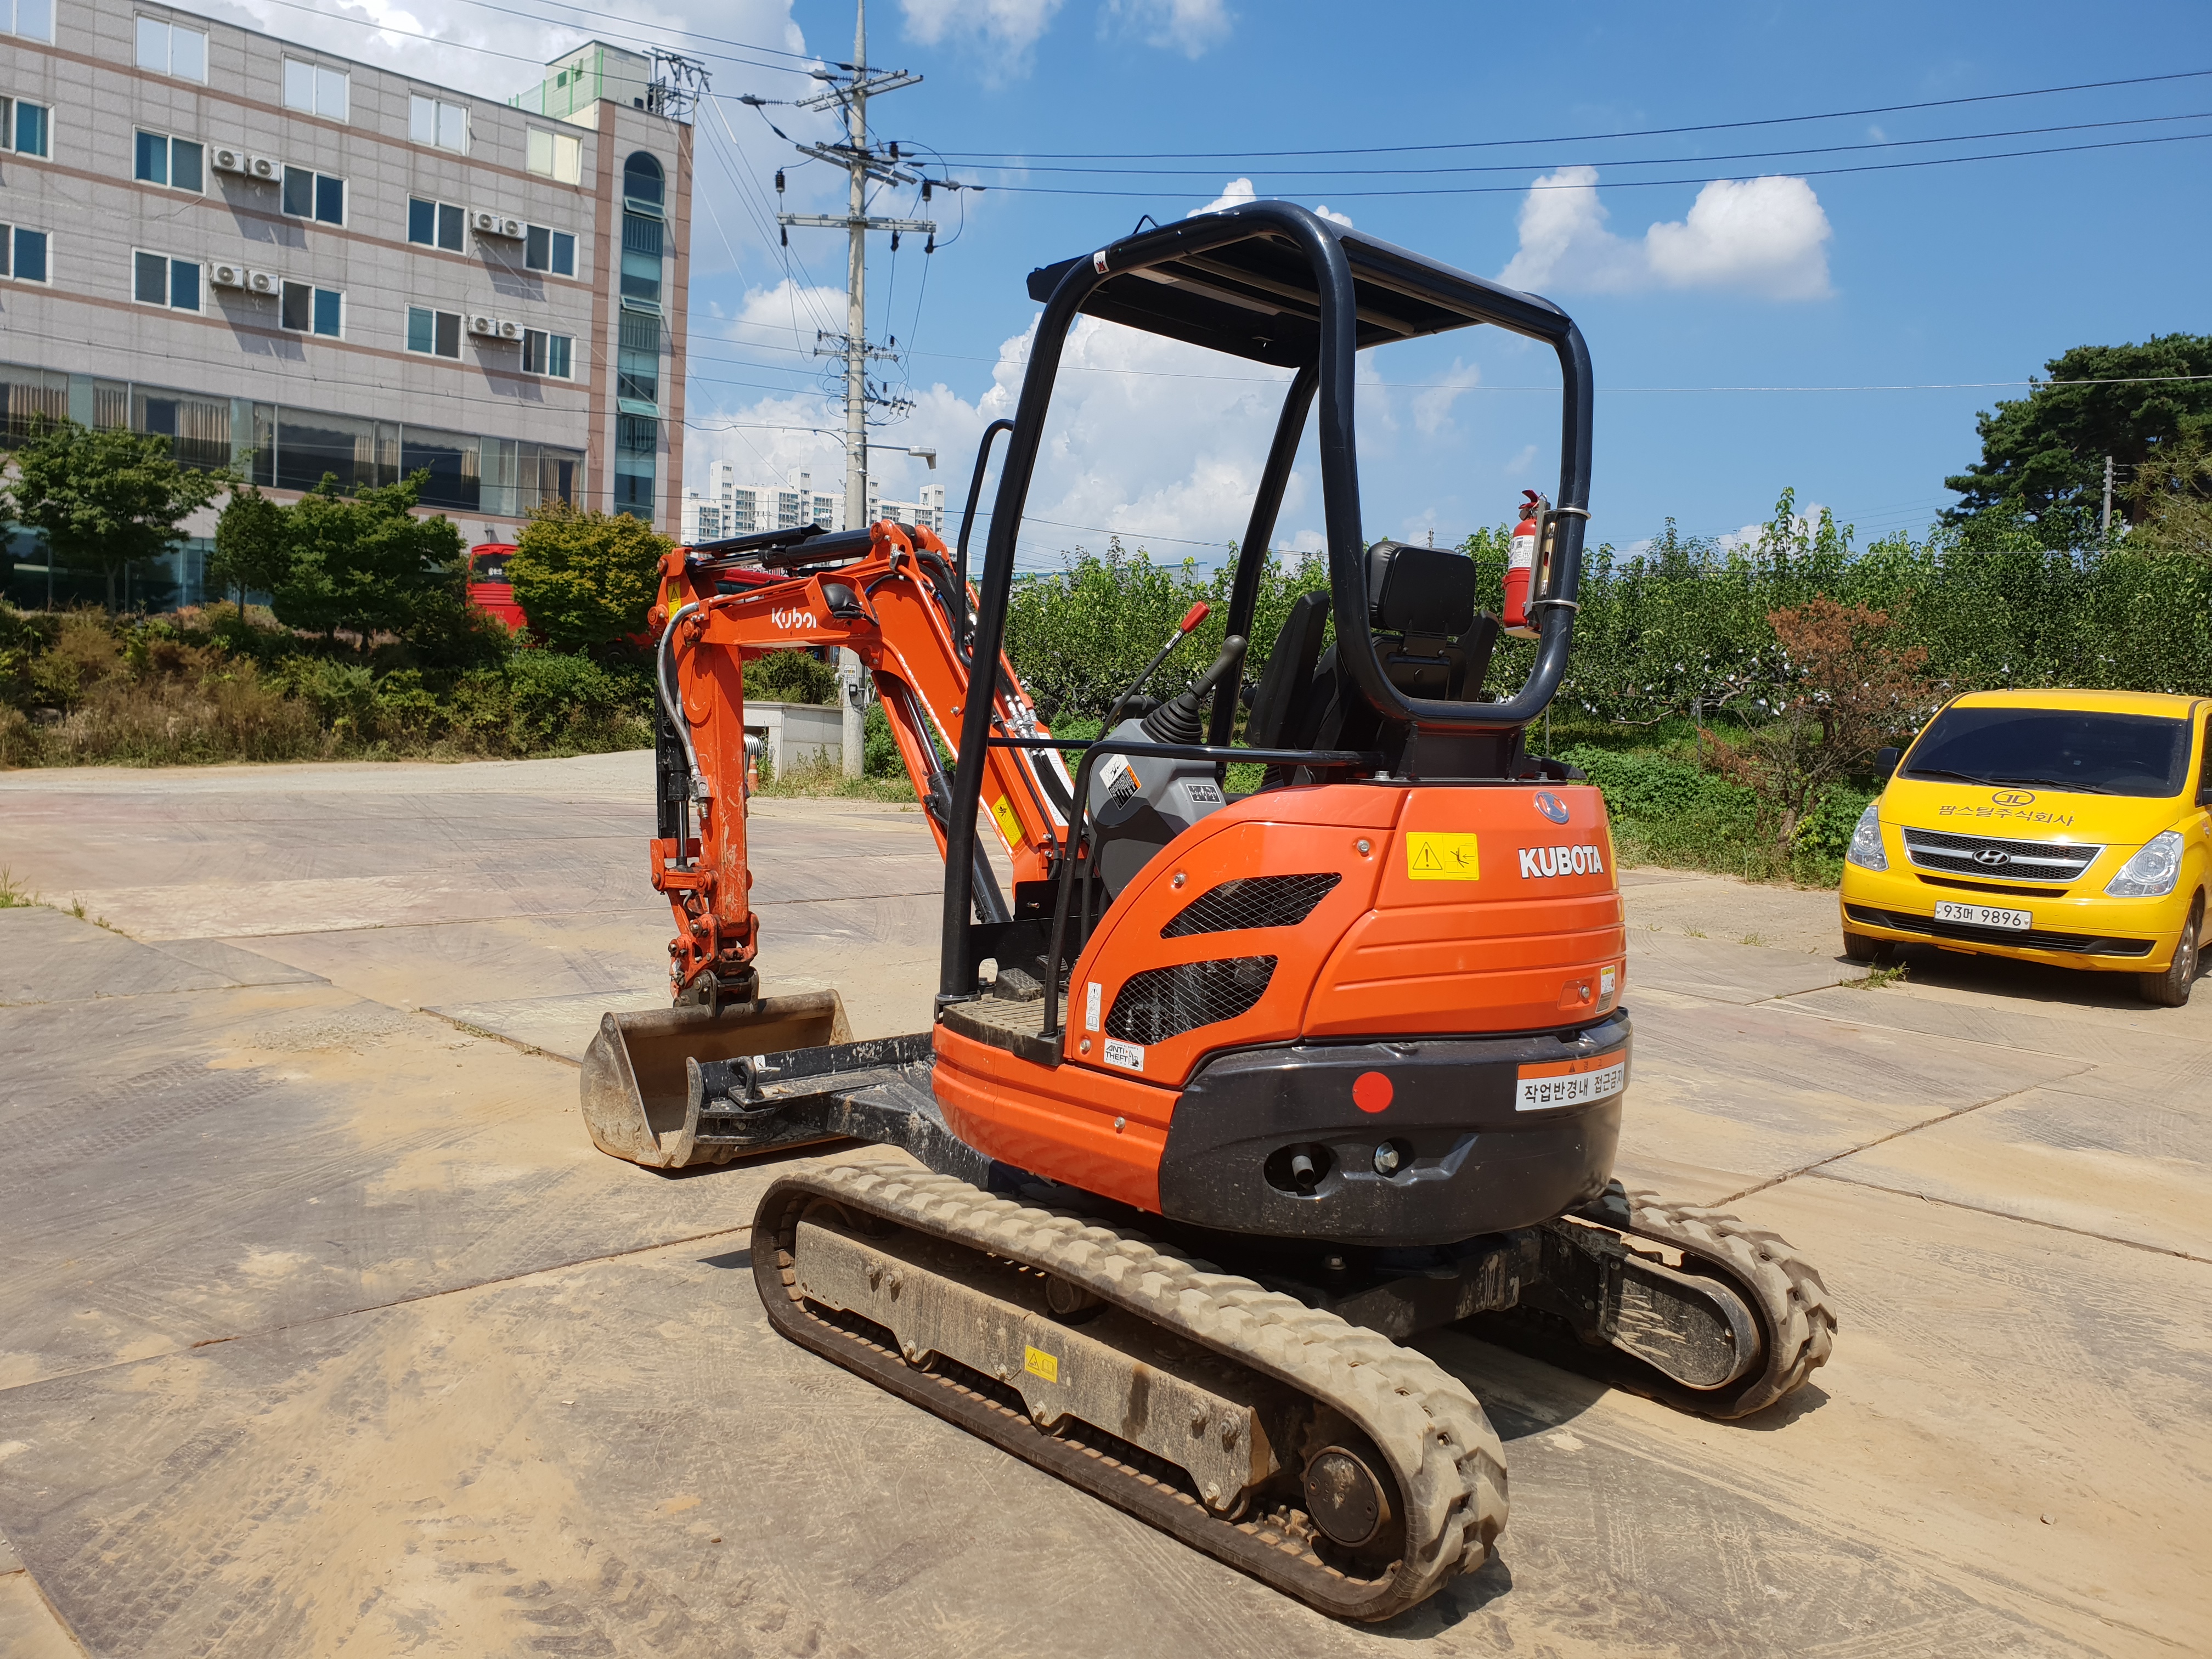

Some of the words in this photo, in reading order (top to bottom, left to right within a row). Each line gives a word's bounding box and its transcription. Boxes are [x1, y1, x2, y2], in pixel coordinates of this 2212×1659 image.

[1938, 805, 2075, 827] 팜스틸주식회사
[1517, 844, 1604, 879] KUBOTA
[1944, 905, 1973, 921] 93머
[1981, 909, 2021, 927] 9896
[1105, 1051, 1128, 1063] THEFT
[1106, 1045, 1125, 1054] ANTI
[1524, 1077, 1589, 1104] 작업반경내
[1594, 1067, 1623, 1094] 접근금지
